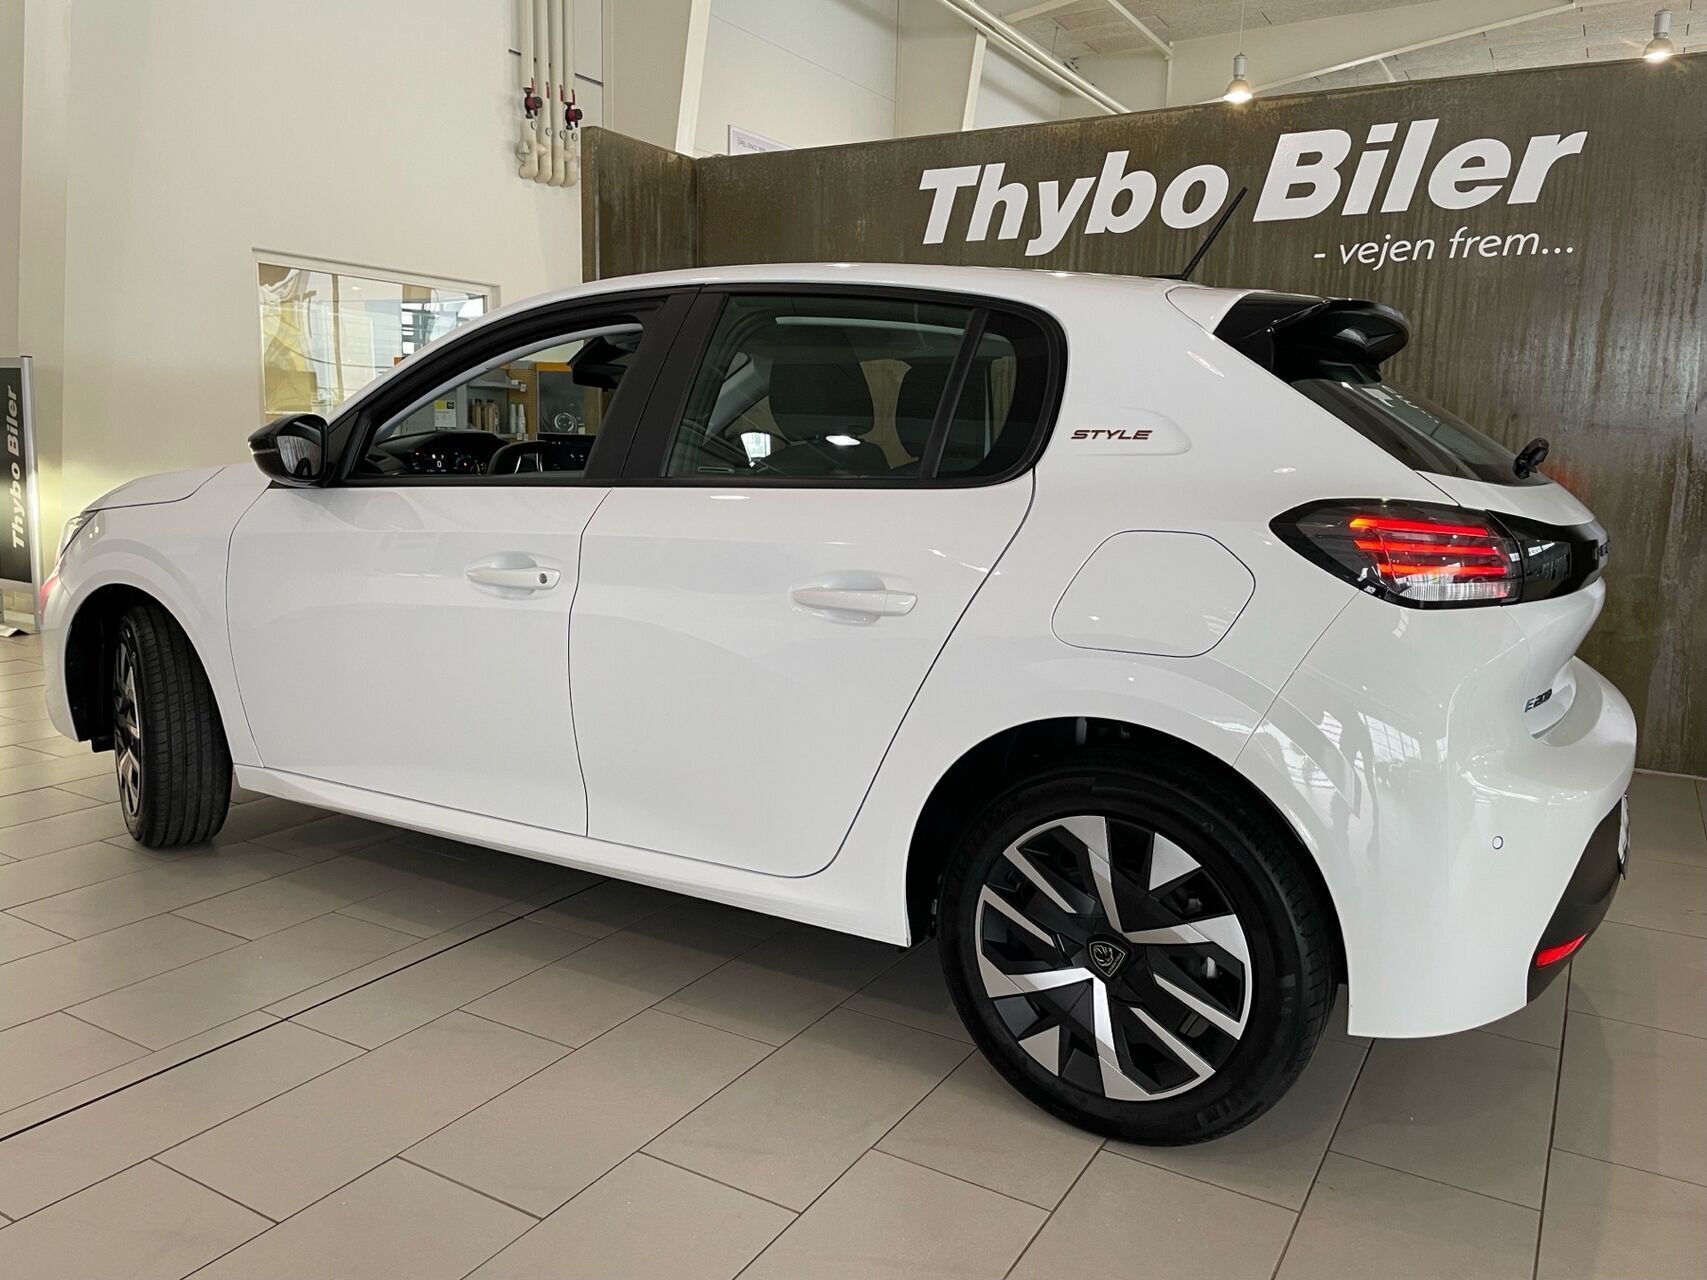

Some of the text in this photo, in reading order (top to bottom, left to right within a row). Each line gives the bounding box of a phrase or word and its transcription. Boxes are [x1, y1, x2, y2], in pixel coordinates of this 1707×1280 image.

[919, 119, 1588, 257] Thybo Biler
[1340, 234, 1435, 271] vejen
[1448, 226, 1574, 259] frem...
[6, 386, 25, 549] Thybo Biler
[1070, 429, 1153, 440] STYLE
